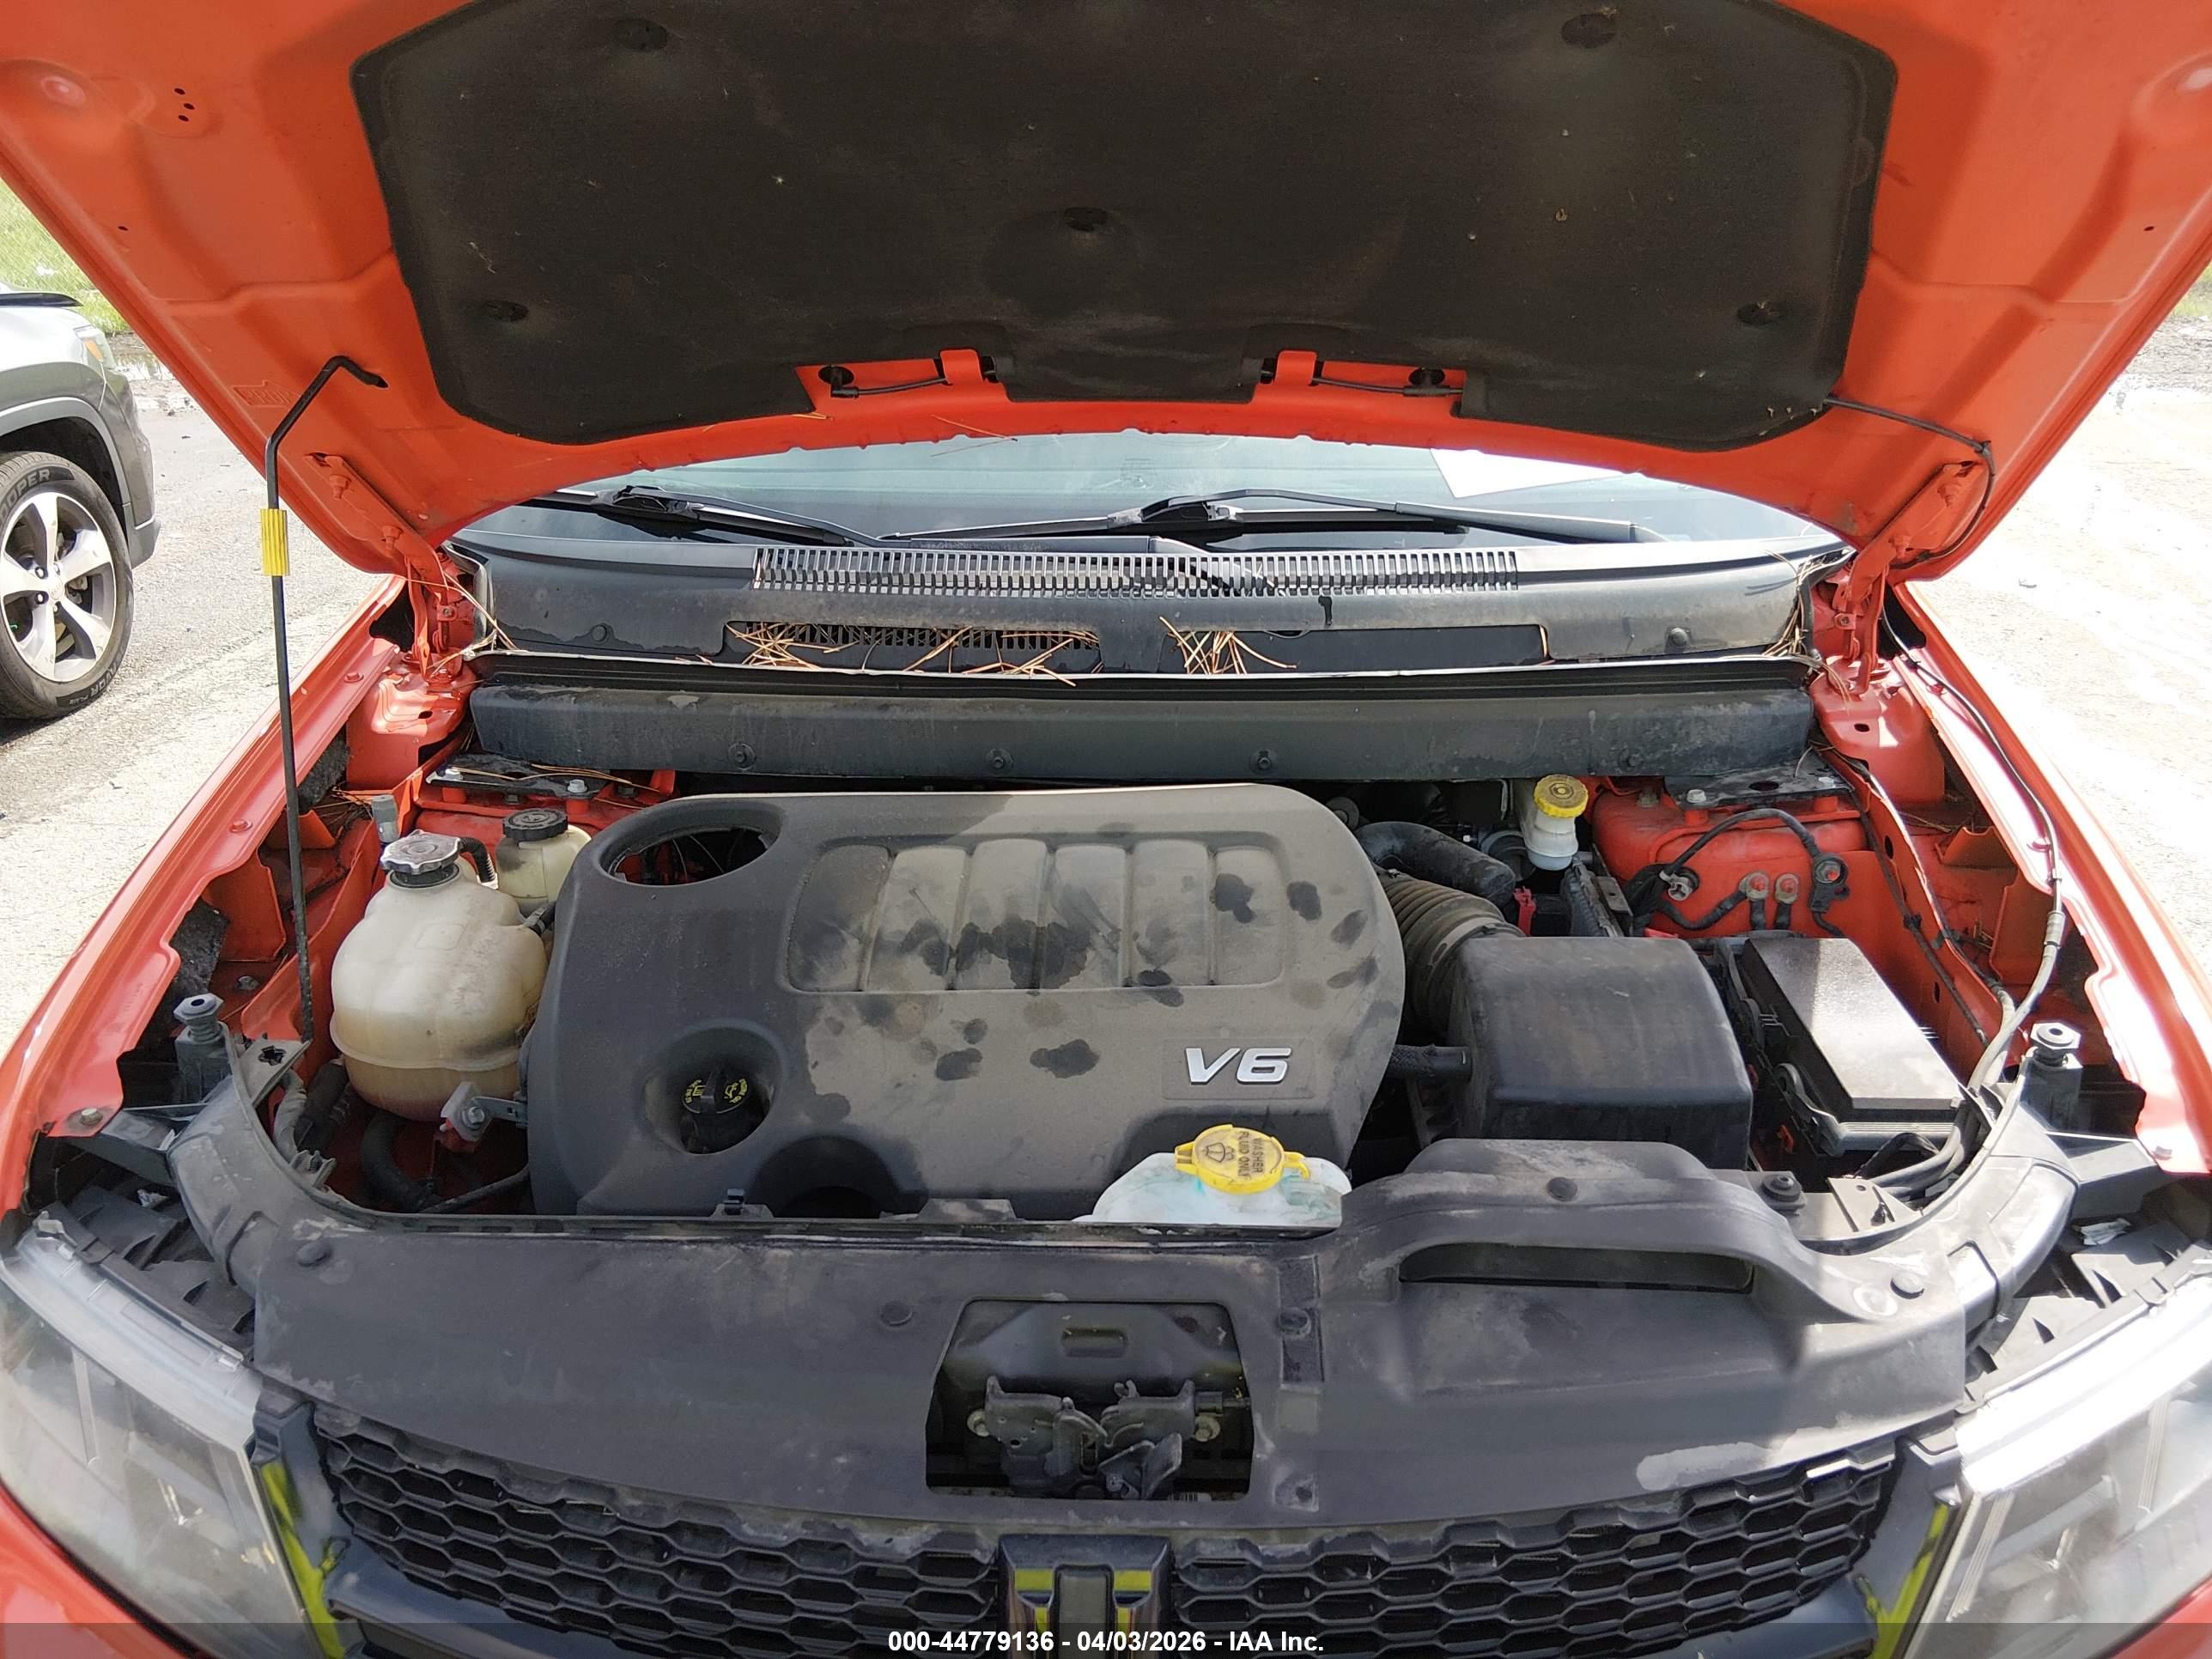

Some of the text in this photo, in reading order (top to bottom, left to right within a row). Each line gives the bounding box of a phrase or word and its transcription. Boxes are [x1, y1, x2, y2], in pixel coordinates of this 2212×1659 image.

[1185, 1047, 1292, 1085] V6
[1238, 1131, 1251, 1180] FLUID ONLY
[1253, 1138, 1264, 1174] WASHER
